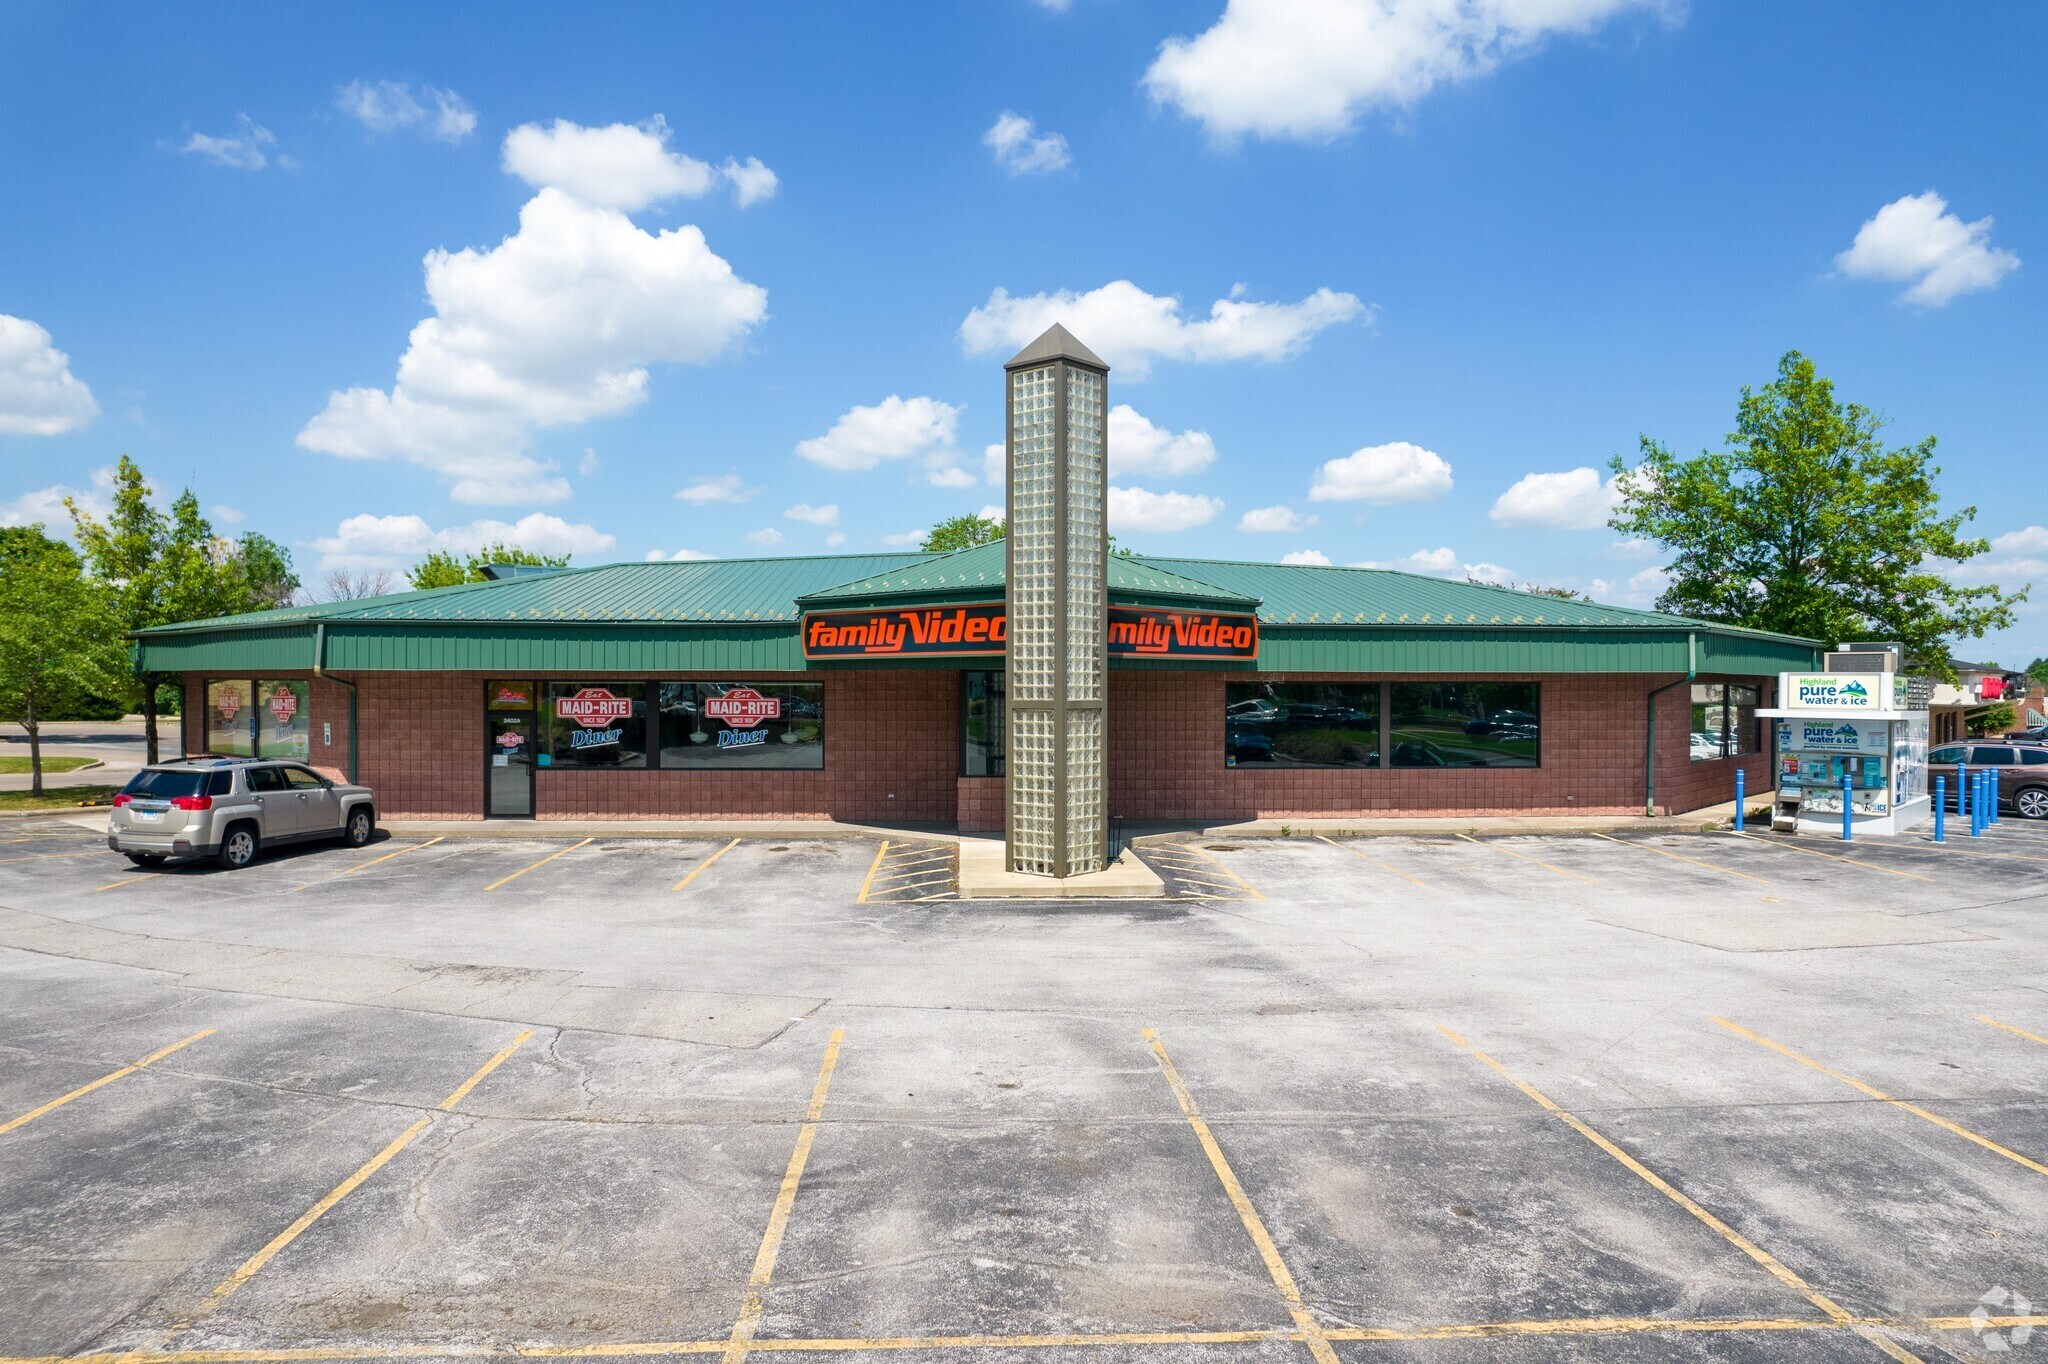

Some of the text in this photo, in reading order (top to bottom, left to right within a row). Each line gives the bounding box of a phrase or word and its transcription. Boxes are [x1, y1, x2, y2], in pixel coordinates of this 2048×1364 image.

[809, 618, 907, 653] family
[1108, 615, 1252, 652] mily Video
[1800, 678, 1837, 687] Highland
[585, 691, 603, 699] Eat
[733, 691, 751, 699] Eat
[1800, 686, 1837, 700] pure
[1805, 696, 1838, 705] water
[1850, 696, 1868, 705] ice
[562, 701, 627, 714] MAID-RITE
[710, 701, 775, 714] MAID-RITE
[1804, 721, 1834, 729] Highland
[571, 728, 623, 748] Diner
[717, 728, 769, 747] Diner
[1804, 728, 1834, 739] pure
[1808, 736, 1835, 744] water
[1844, 736, 1858, 744] ice
